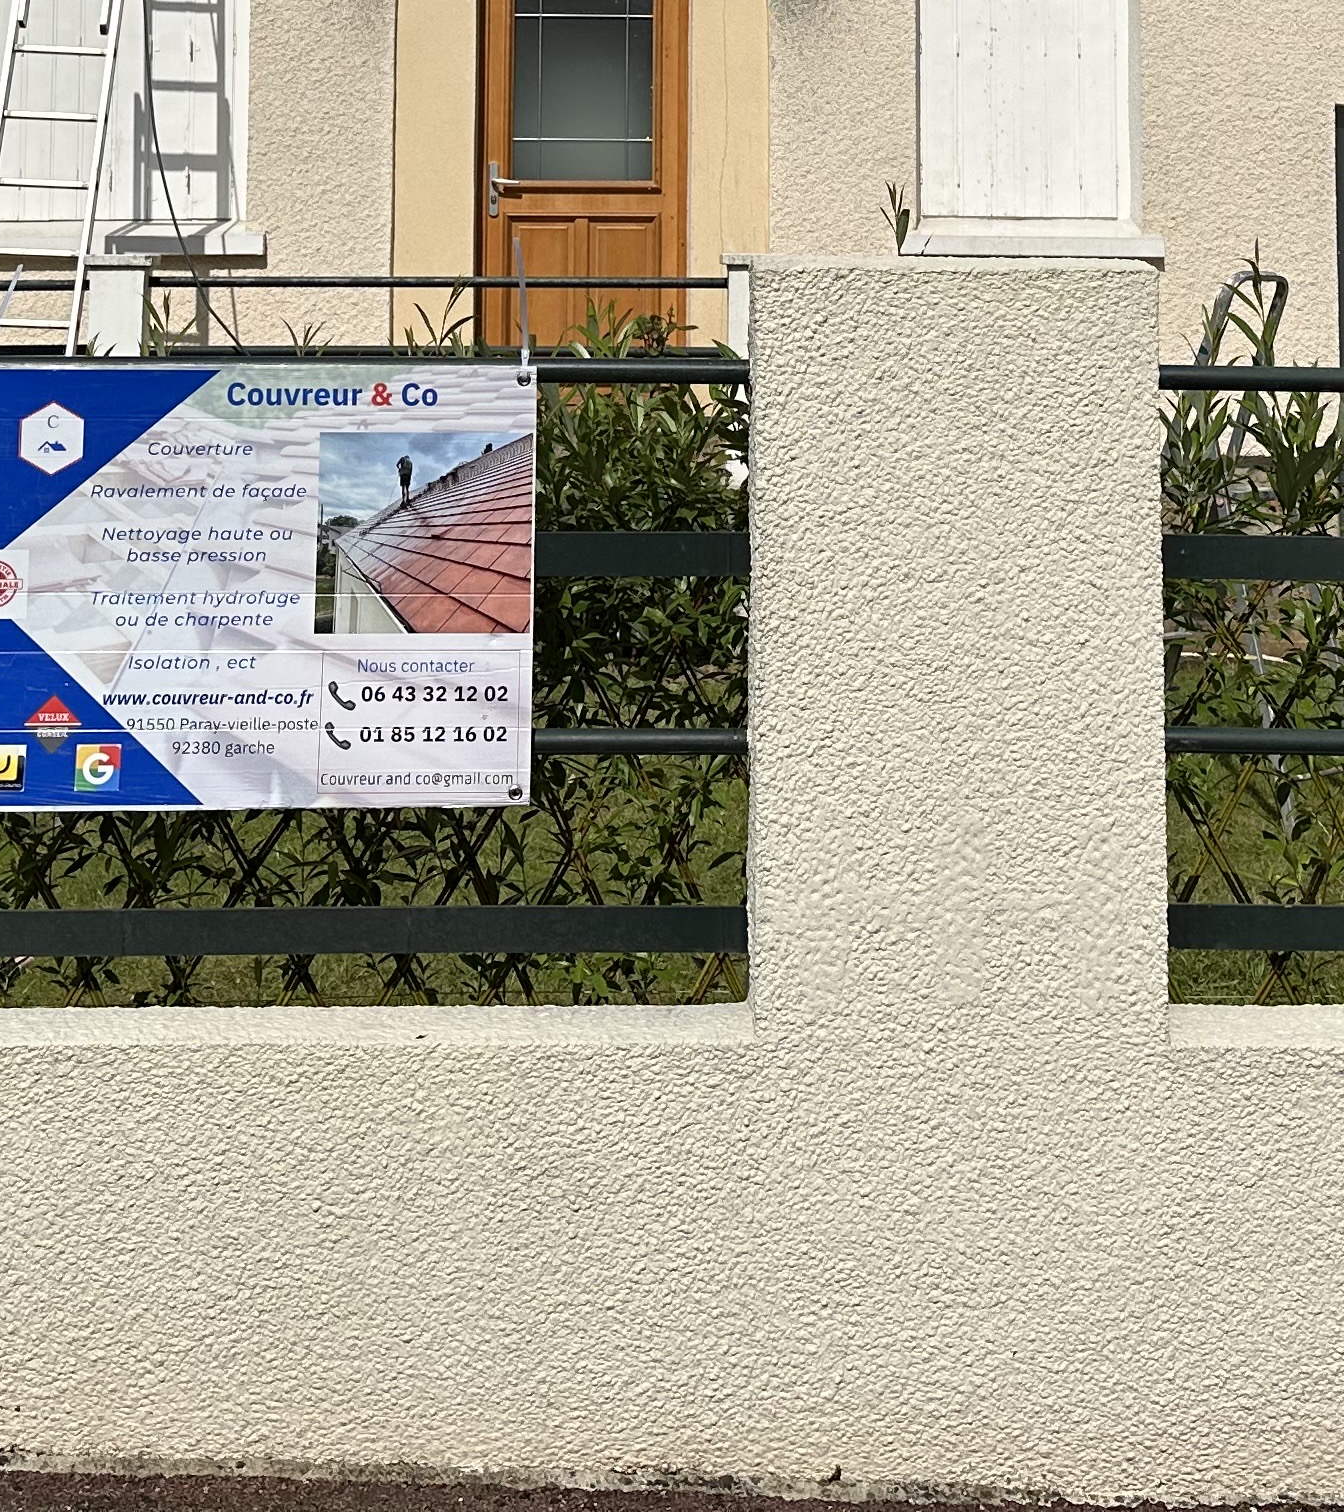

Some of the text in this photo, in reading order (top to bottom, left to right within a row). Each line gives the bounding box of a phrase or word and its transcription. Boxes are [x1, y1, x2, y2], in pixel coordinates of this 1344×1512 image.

[227, 382, 439, 406] Couvreur & Co
[47, 414, 60, 429] C
[148, 441, 254, 456] Couverture
[90, 483, 307, 502] Ravalement de façade
[101, 527, 294, 544] Nettoyage haute ou
[126, 548, 267, 565] basse pression
[91, 590, 301, 608] Traitement hydrofuge
[115, 612, 274, 629] ou de charpente
[128, 655, 211, 670] Isolation
[226, 656, 257, 670] ect
[357, 658, 476, 674] Nous contacter
[102, 689, 314, 709] www.couvreur-and-co.fr
[361, 686, 508, 702] 06 43 32 12 02
[37, 712, 70, 722] VELUX
[126, 717, 319, 735] 91550 Paray-vieille-poste
[360, 726, 508, 742] 01 85 12 16 02
[172, 741, 275, 758] 92380 garche
[82, 752, 115, 785] G
